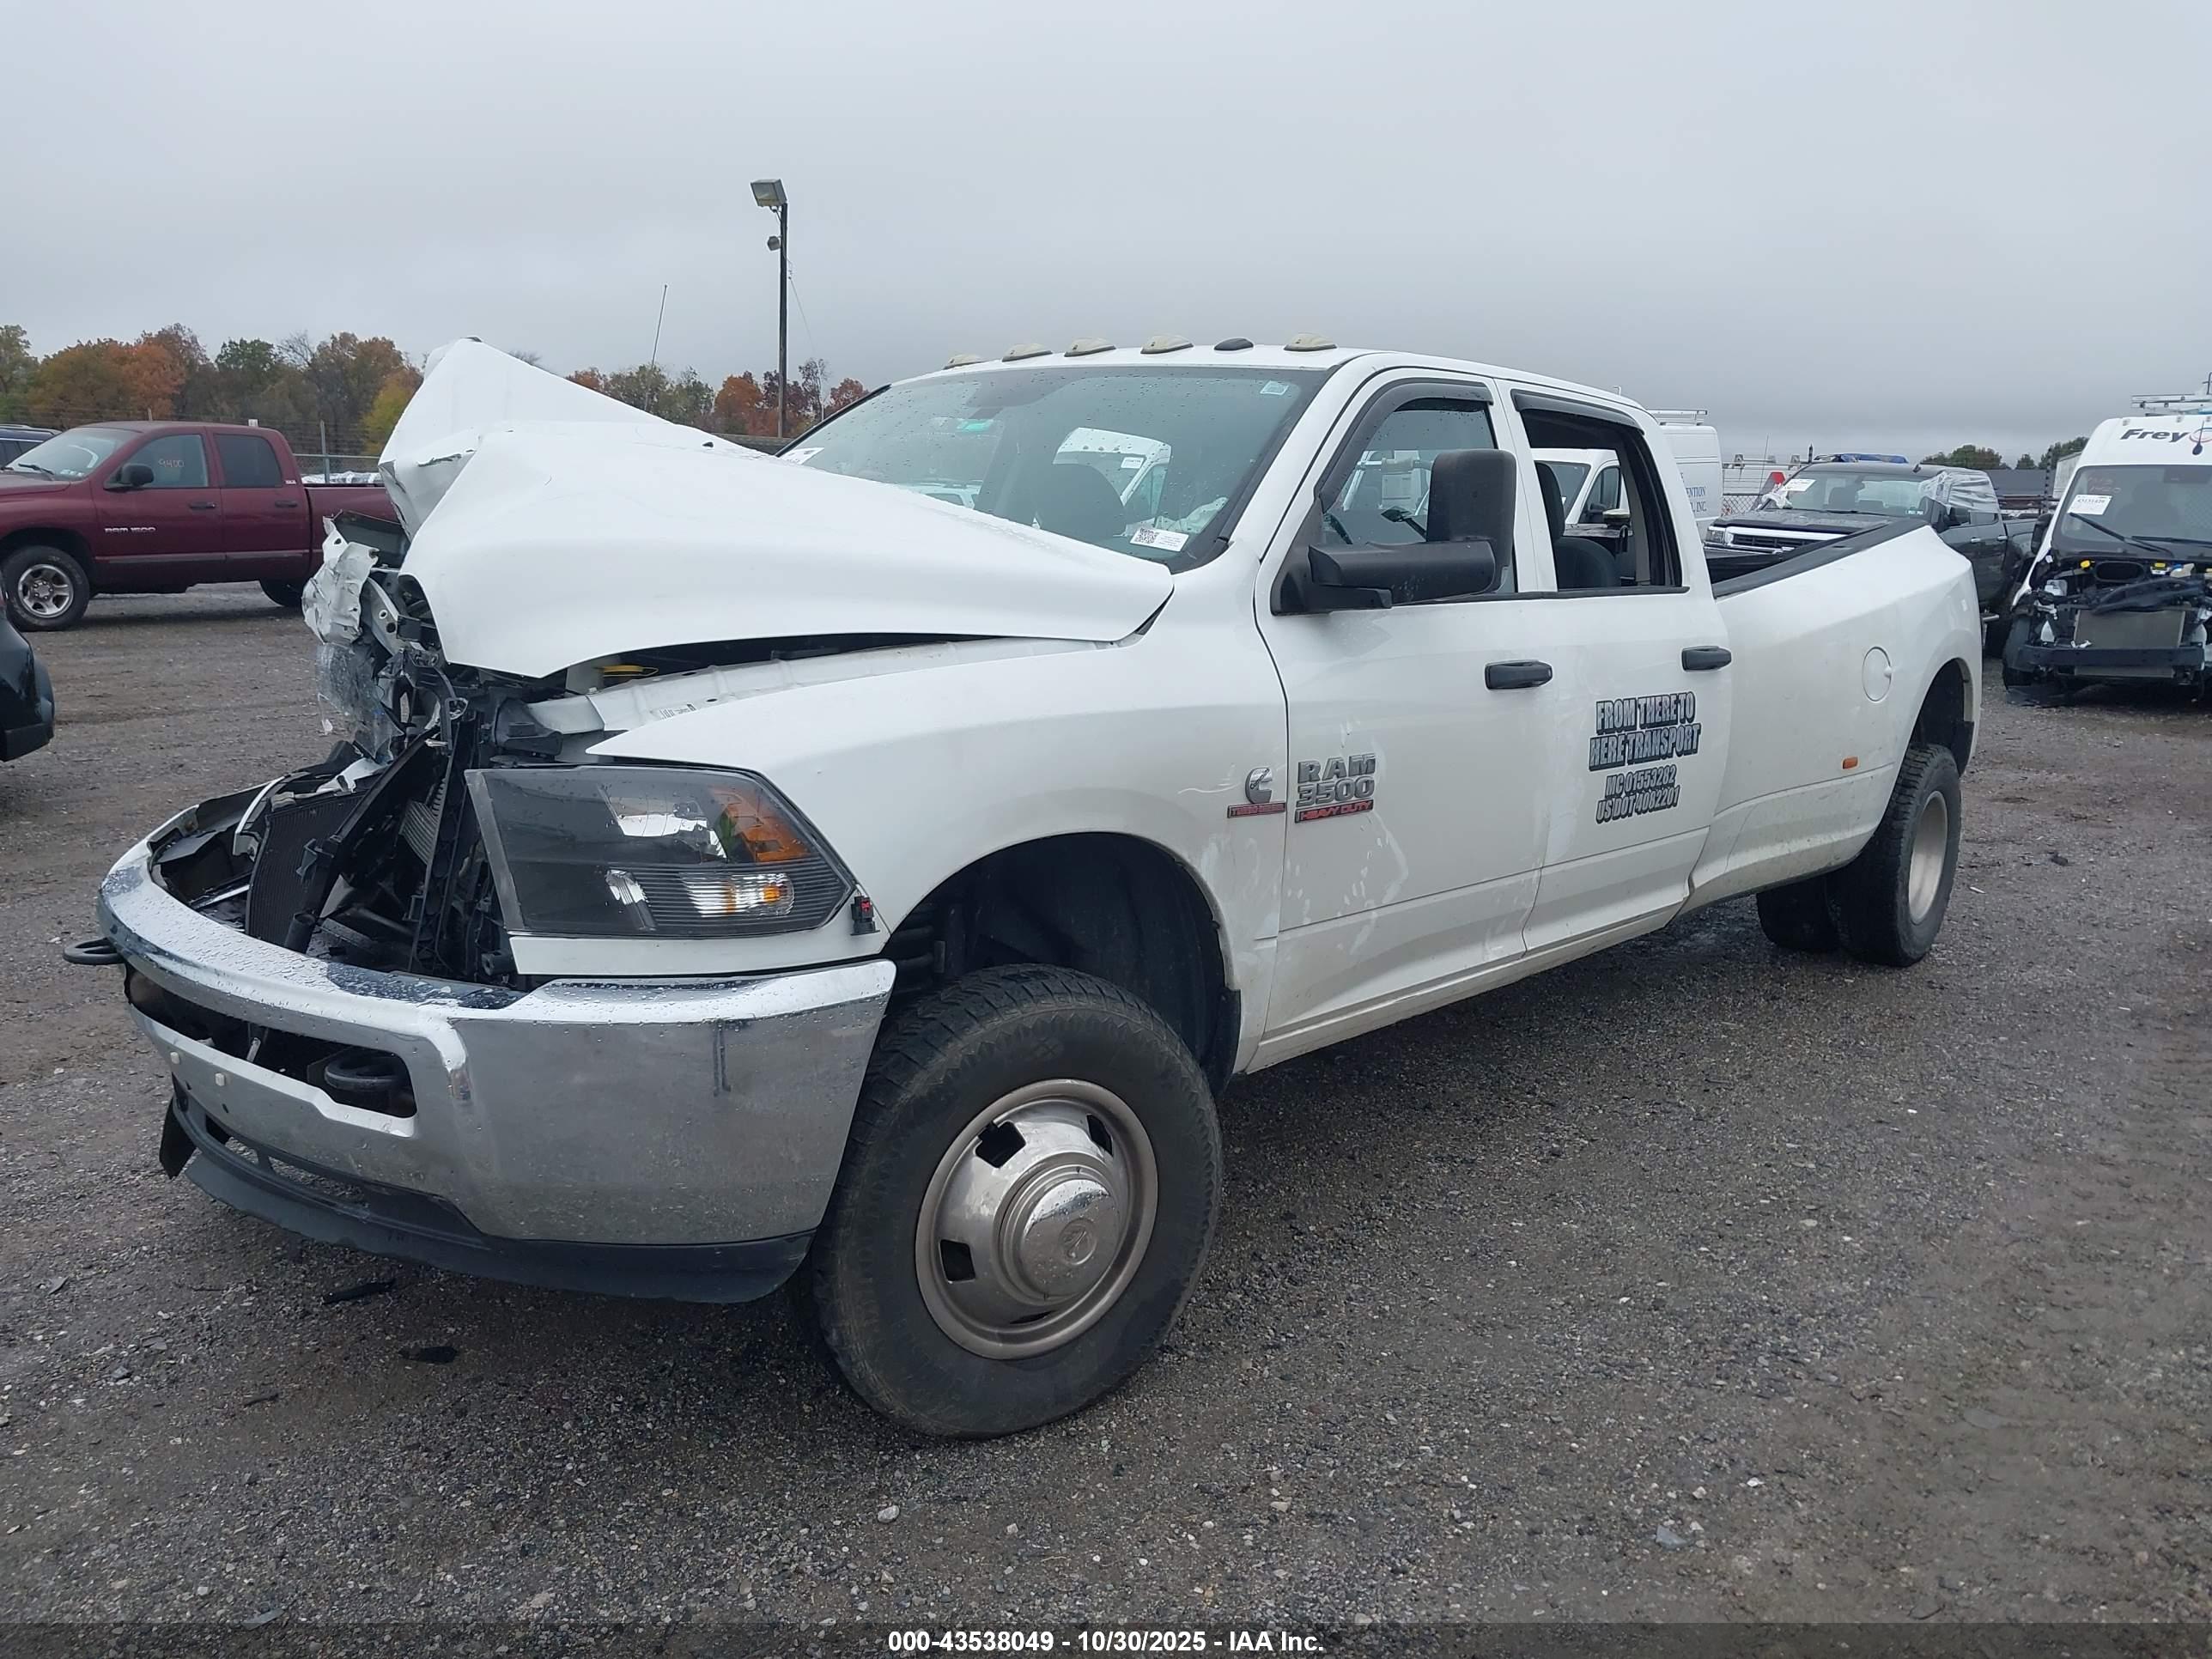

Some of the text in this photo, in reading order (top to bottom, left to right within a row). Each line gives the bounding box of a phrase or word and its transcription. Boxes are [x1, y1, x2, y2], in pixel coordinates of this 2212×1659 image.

[2120, 428, 2191, 443] Frey
[1596, 691, 1696, 735] FROM THERE TO
[1589, 723, 1702, 772] HERE TRANSPORT
[1298, 753, 1376, 784] RAM
[1605, 764, 1677, 799] MC 01553282
[1296, 776, 1375, 808] 3500
[1300, 805, 1341, 821] HEAVY
[1341, 800, 1371, 815] DUTY
